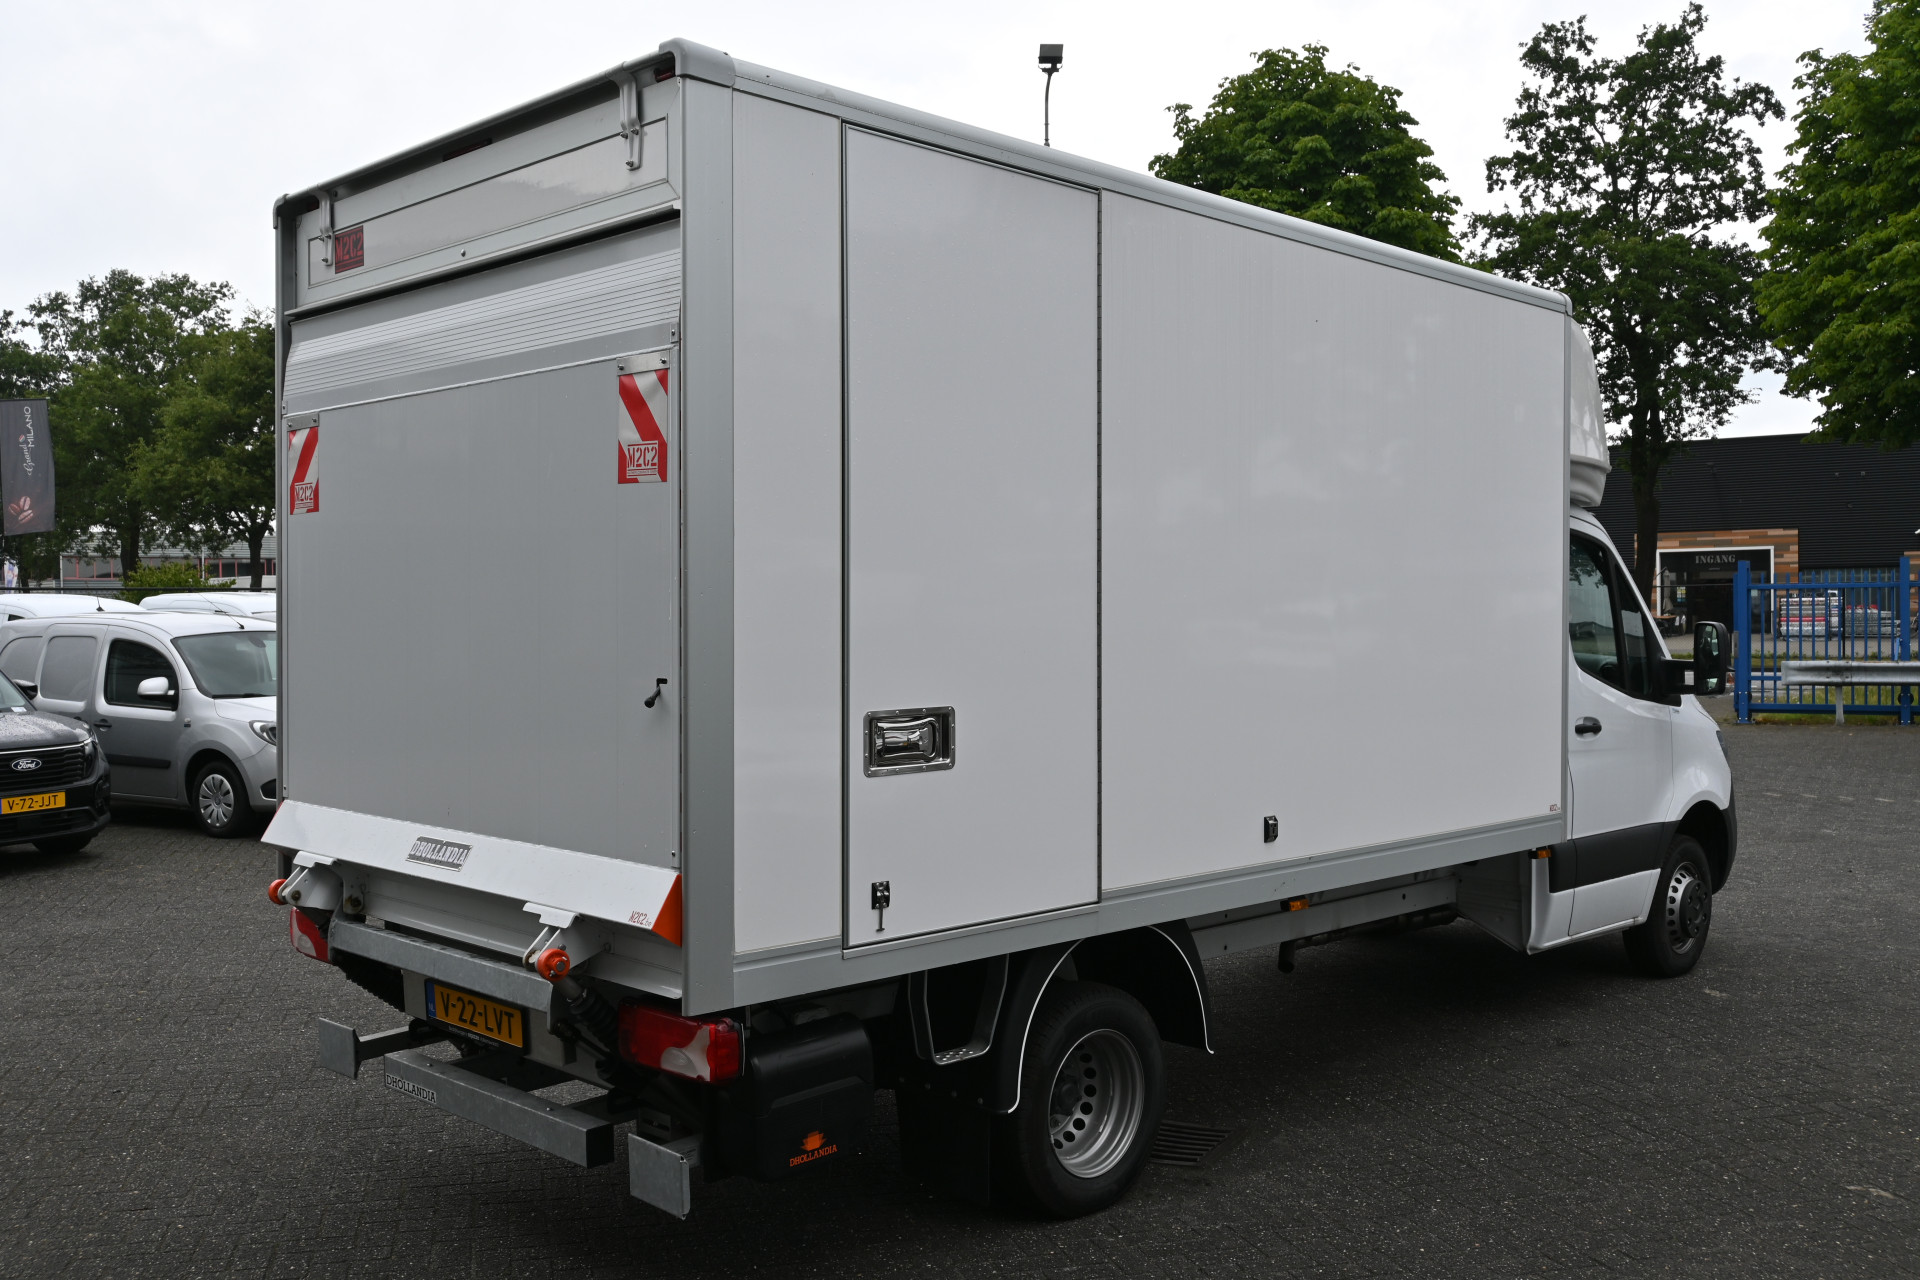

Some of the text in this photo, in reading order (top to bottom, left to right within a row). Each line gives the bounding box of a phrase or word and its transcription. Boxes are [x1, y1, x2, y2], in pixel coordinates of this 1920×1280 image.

[335, 231, 364, 263] M2C2
[23, 406, 35, 447] MILANO
[19, 444, 35, 476] Grand
[627, 446, 658, 468] M2C2
[295, 485, 314, 502] M2C2
[1695, 554, 1736, 564] INGANG
[17, 760, 37, 769] Ford
[7, 794, 59, 811] V-72-JJT
[409, 840, 468, 865] DHOLLANDIA
[440, 990, 515, 1040] V-22-LVT
[386, 1074, 437, 1104] DHOLLANDIA
[789, 1144, 838, 1168] DHOLLANDIA
